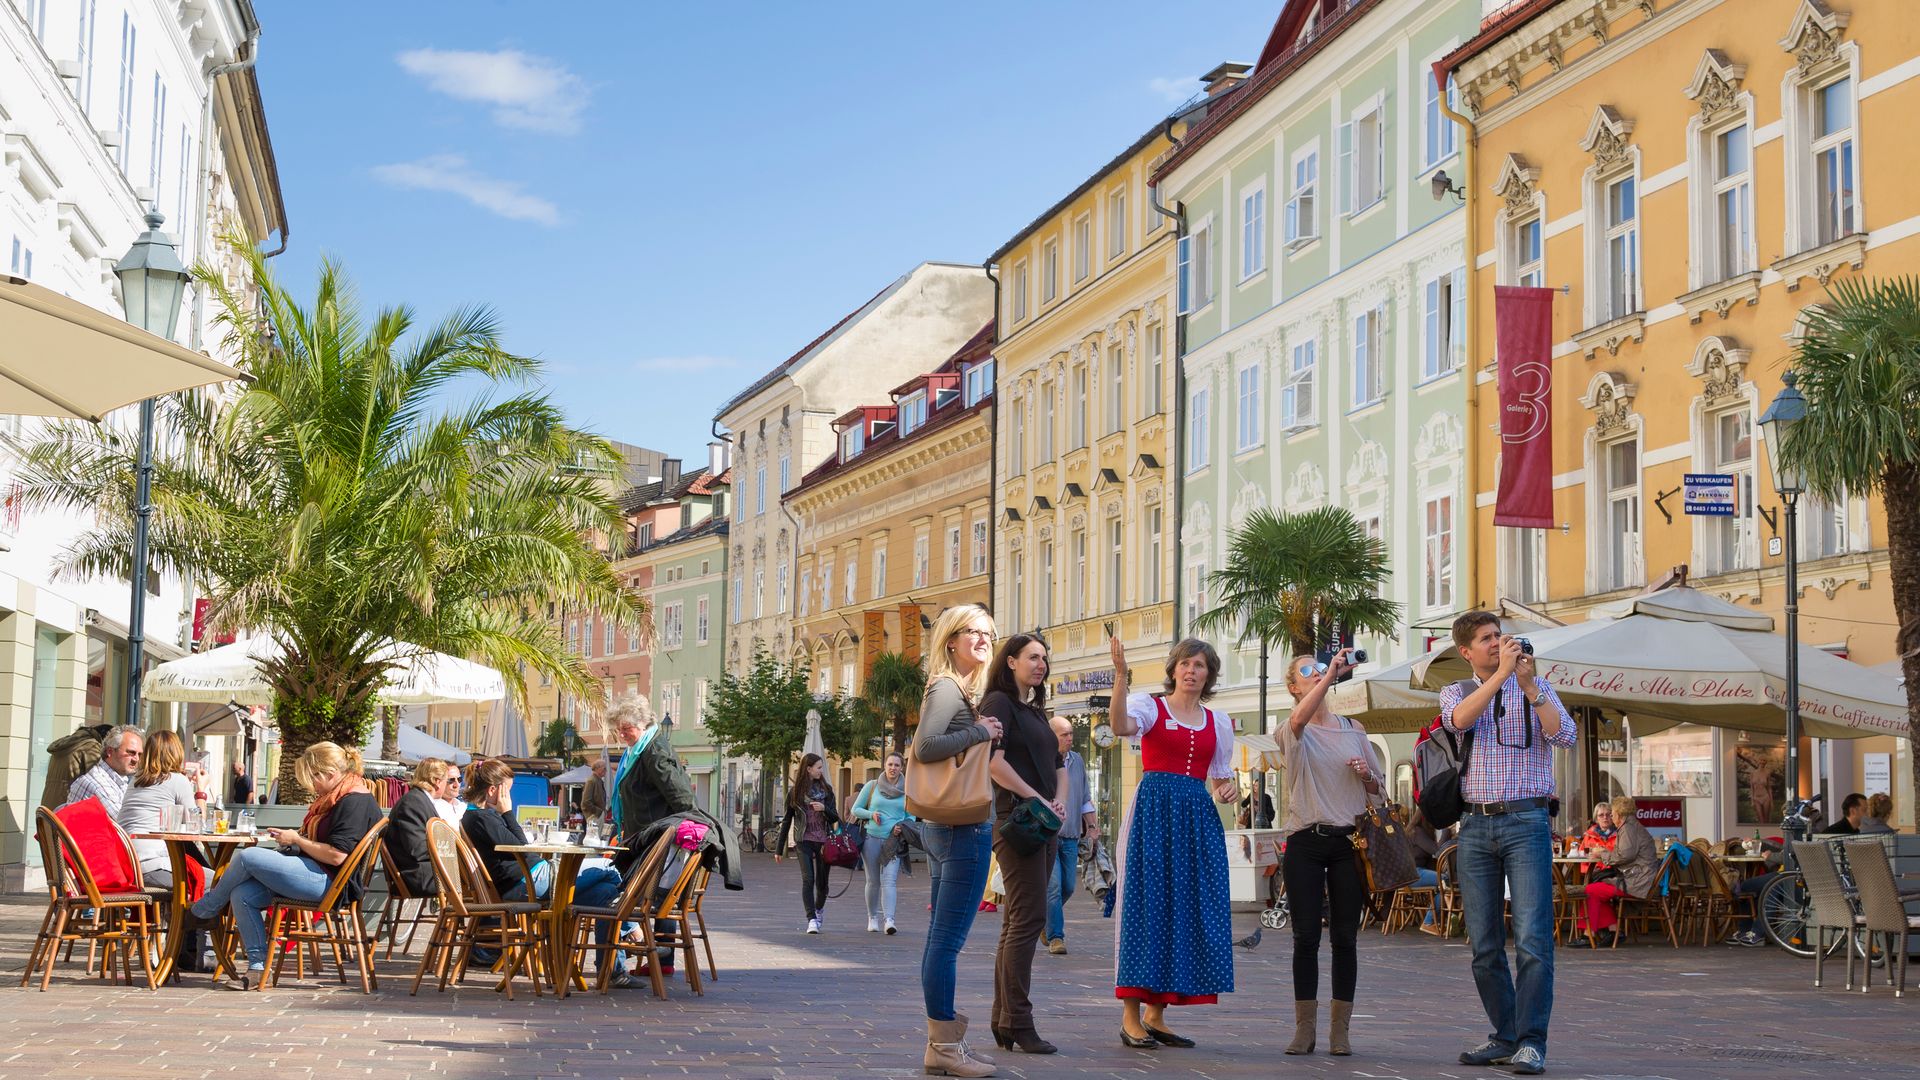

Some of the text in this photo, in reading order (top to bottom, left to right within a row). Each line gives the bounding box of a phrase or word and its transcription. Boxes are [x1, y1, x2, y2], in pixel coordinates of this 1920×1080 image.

[1502, 361, 1552, 444] 3
[1506, 404, 1528, 413] Galerie
[1545, 663, 1754, 699] Eis Café Alter Platz
[1832, 704, 1909, 732] Caffetteria
[1636, 808, 1681, 820] Galerie 3
